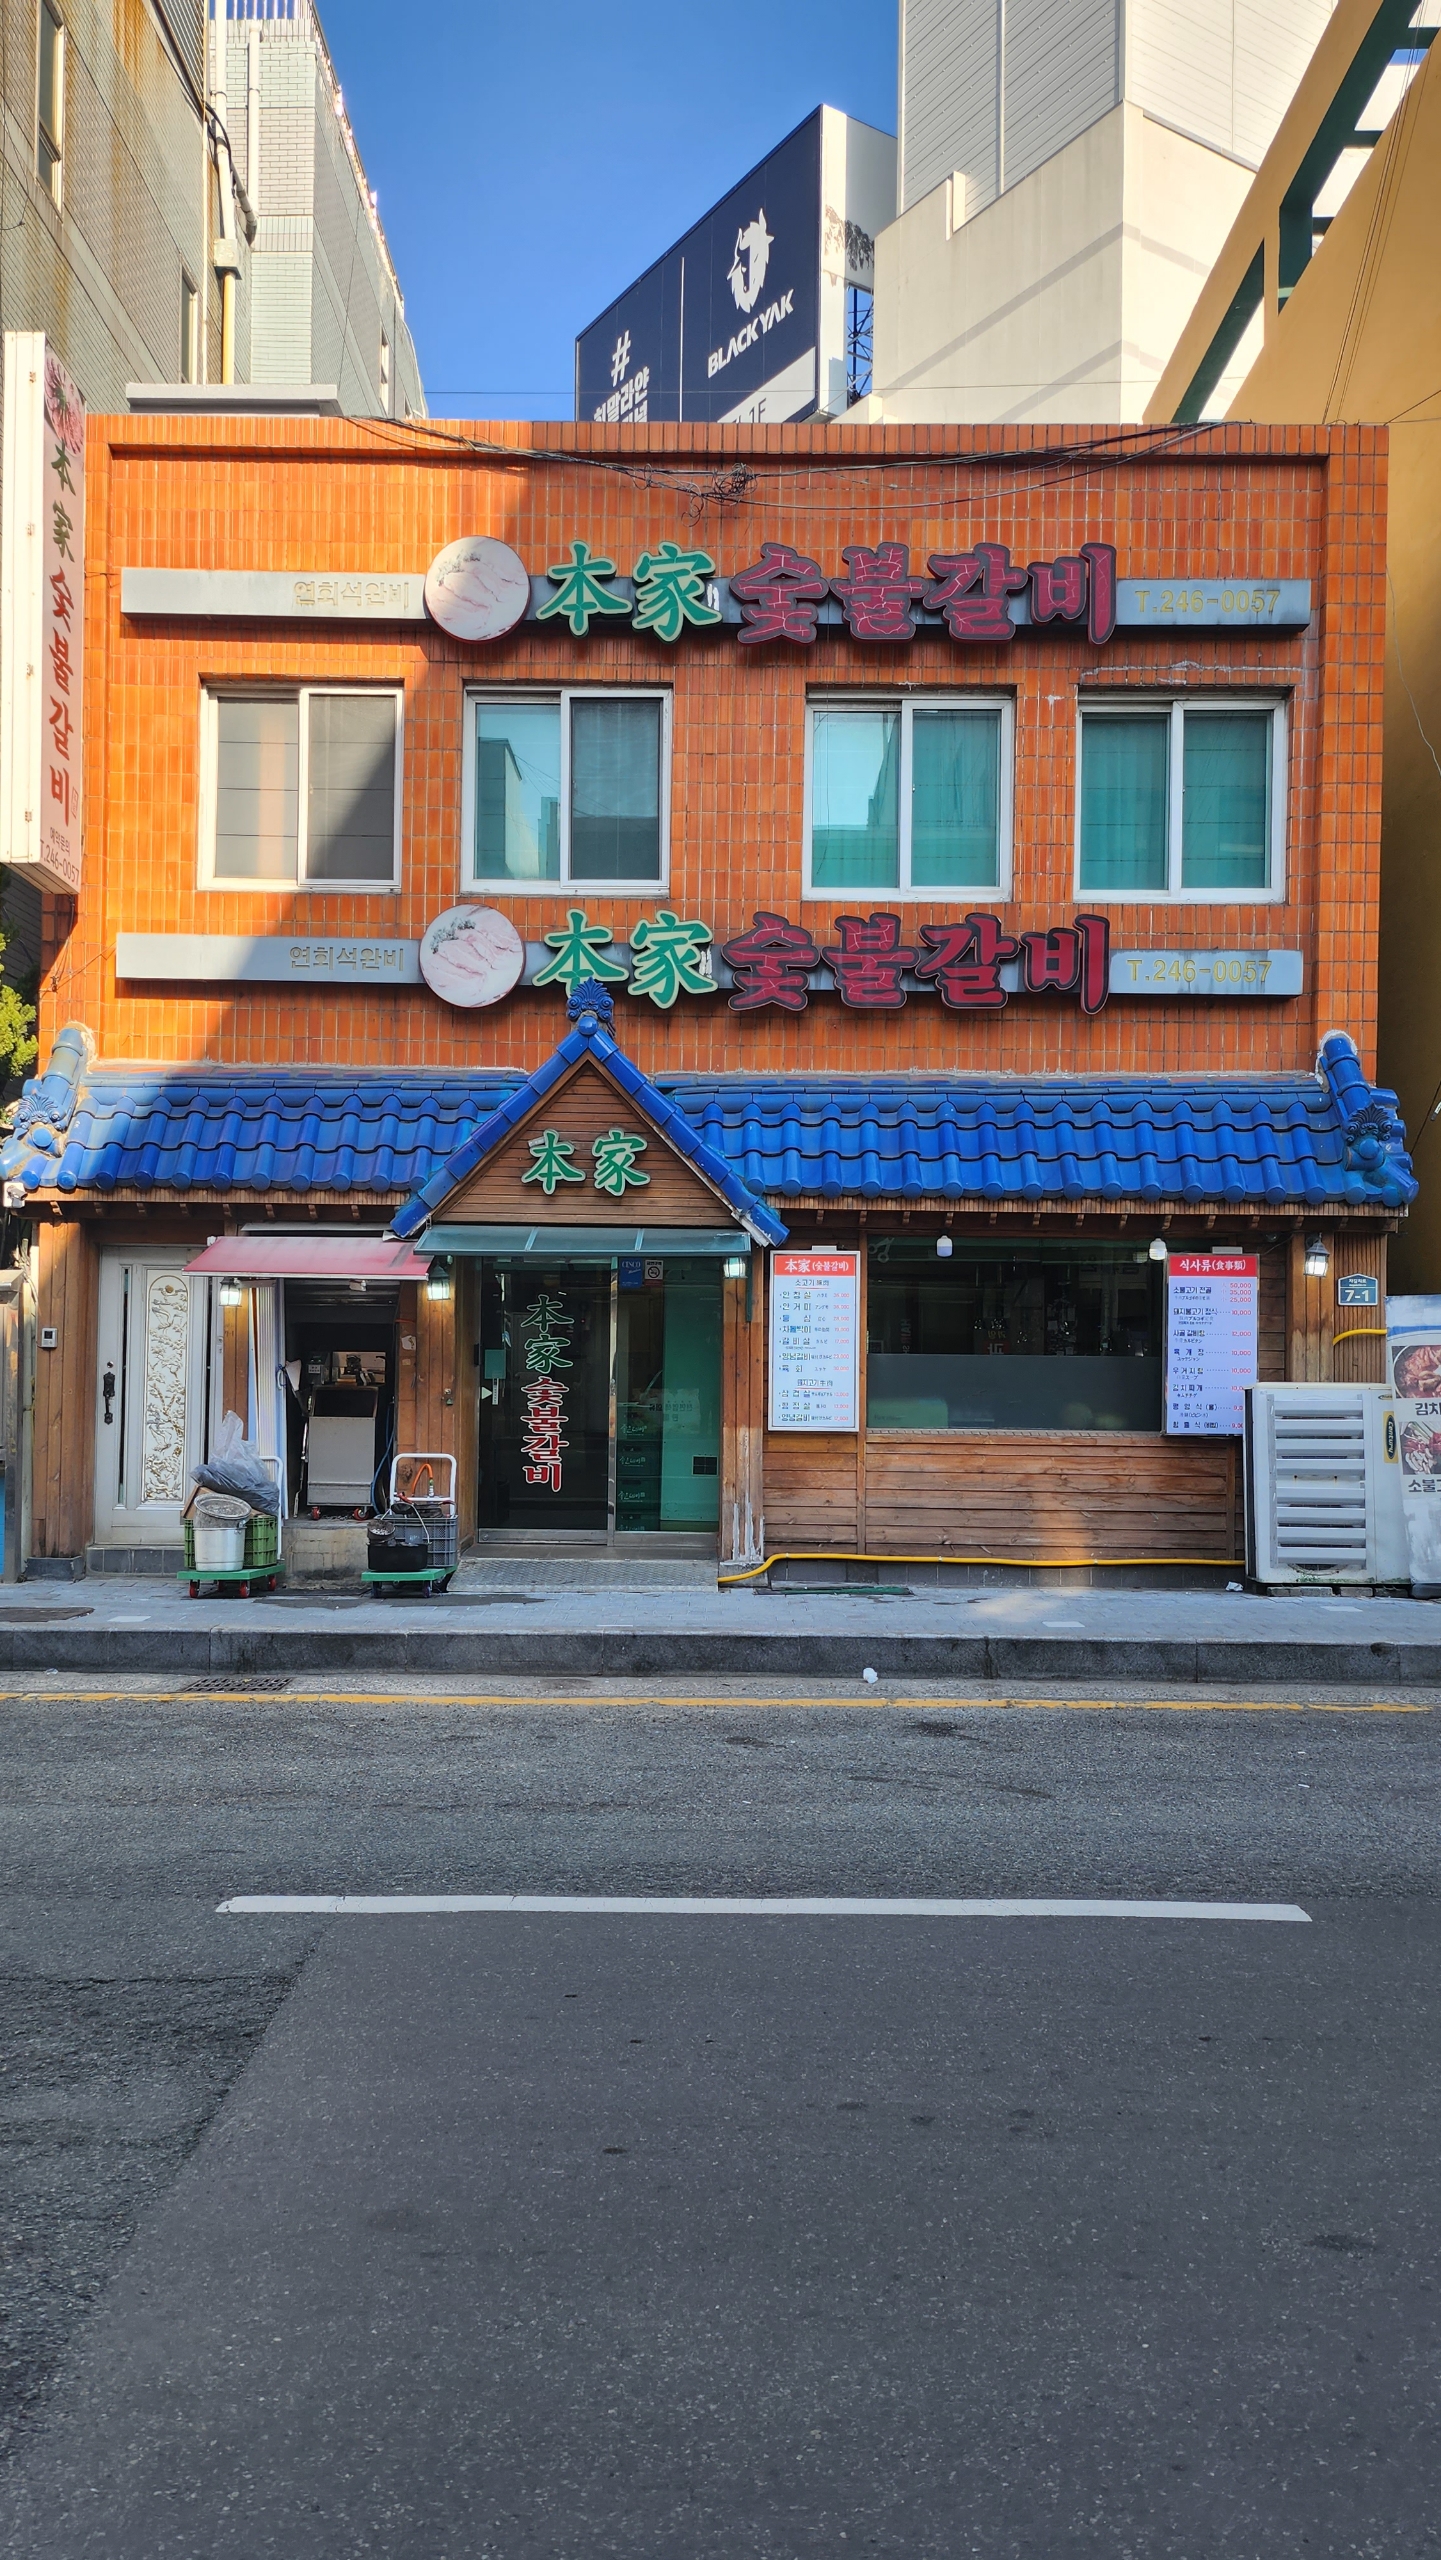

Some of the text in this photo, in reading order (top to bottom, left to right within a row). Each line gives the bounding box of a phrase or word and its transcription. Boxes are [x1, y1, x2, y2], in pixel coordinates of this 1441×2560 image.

[293, 580, 410, 608] 연회석완비
[536, 540, 1116, 645] 本家 숯불갈비
[1134, 589, 1280, 614] T.246-0057
[50, 825, 71, 857] 예약문의
[40, 838, 80, 887] T.246-0057
[289, 945, 404, 971] 연회석완비
[532, 908, 1110, 1015] 本家 숯불갈비
[1127, 959, 1272, 984] T.246-0057
[521, 1127, 651, 1197] 本家
[784, 1258, 811, 1273] 本家
[795, 1279, 815, 1287] 소고기
[1173, 1286, 1198, 1294] 소불고기
[1344, 1289, 1369, 1302] 7-1
[520, 1294, 575, 1493] 本家 숯불갈비
[1173, 1384, 1203, 1392] 김치찌개
